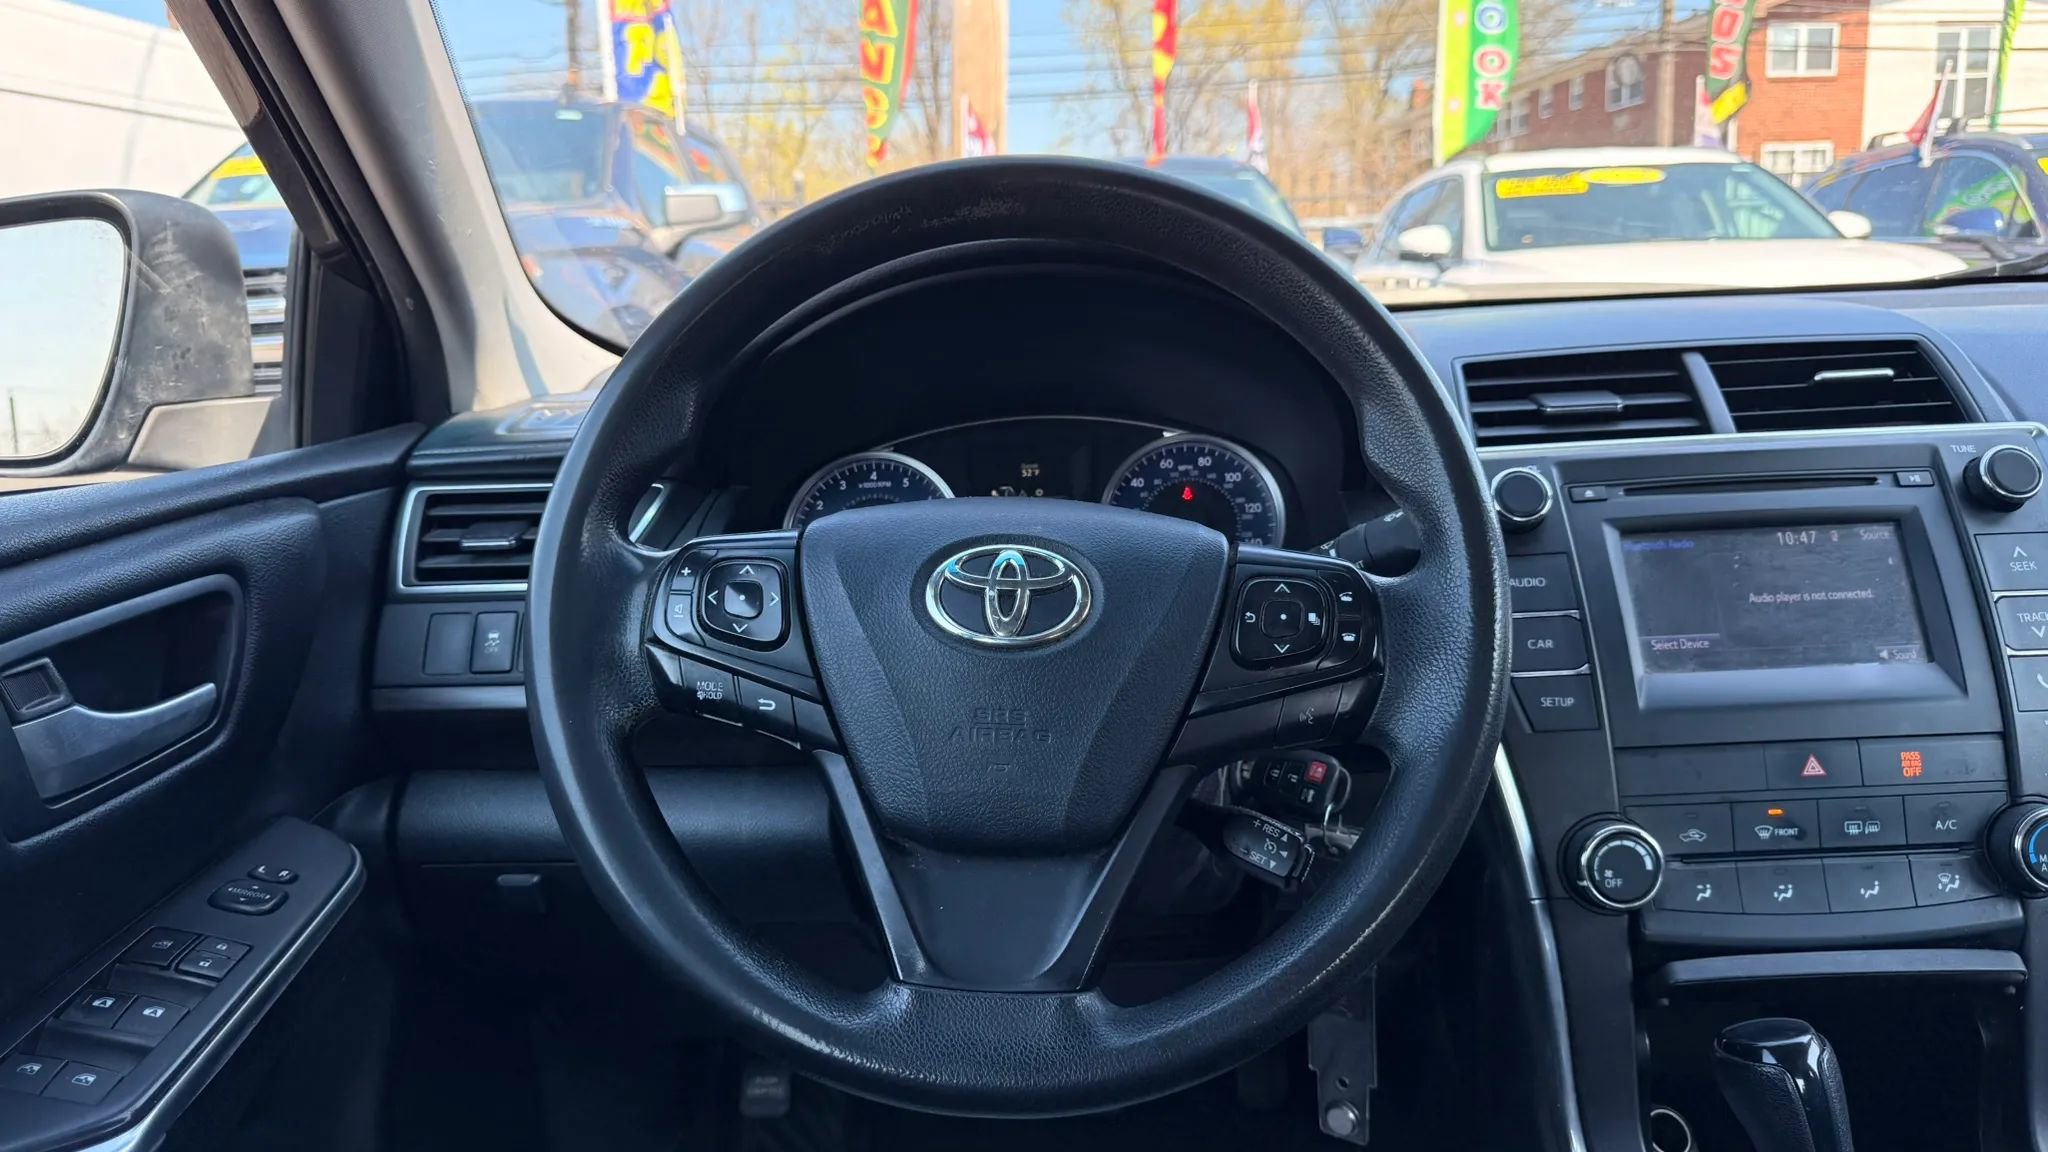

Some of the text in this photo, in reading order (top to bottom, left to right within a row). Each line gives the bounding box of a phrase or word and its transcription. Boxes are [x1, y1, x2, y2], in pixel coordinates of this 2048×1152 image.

[1950, 444, 1977, 453] TUNE
[1160, 458, 1174, 469] 60
[1197, 456, 1212, 467] 80
[870, 471, 877, 480] 4
[1224, 472, 1242, 482] 100
[840, 480, 847, 490] 3
[902, 478, 909, 488] 5
[1130, 477, 1145, 488] 40
[816, 500, 824, 511] 2
[1244, 503, 1262, 513] 120
[1777, 530, 1817, 546] 10:47
[1859, 528, 1890, 541] Source
[2009, 561, 2038, 572] SEEK
[1507, 576, 1546, 588] AUDIO
[1749, 587, 1874, 604] Audio player is not connected.
[1527, 638, 1555, 650] CAR
[1650, 638, 1711, 651] Select Device
[1540, 696, 1575, 708] SETUP
[975, 707, 1027, 722] SRS
[948, 727, 1052, 743] AIRBAG
[1900, 751, 1921, 761] PASS
[1903, 767, 1922, 777] OFF
[1262, 823, 1280, 838] RES
[1935, 819, 1958, 831] A/C
[1775, 827, 1799, 836] FRONT
[1248, 850, 1268, 865] SET
[258, 865, 266, 873] L
[1604, 879, 1623, 889] OFF
